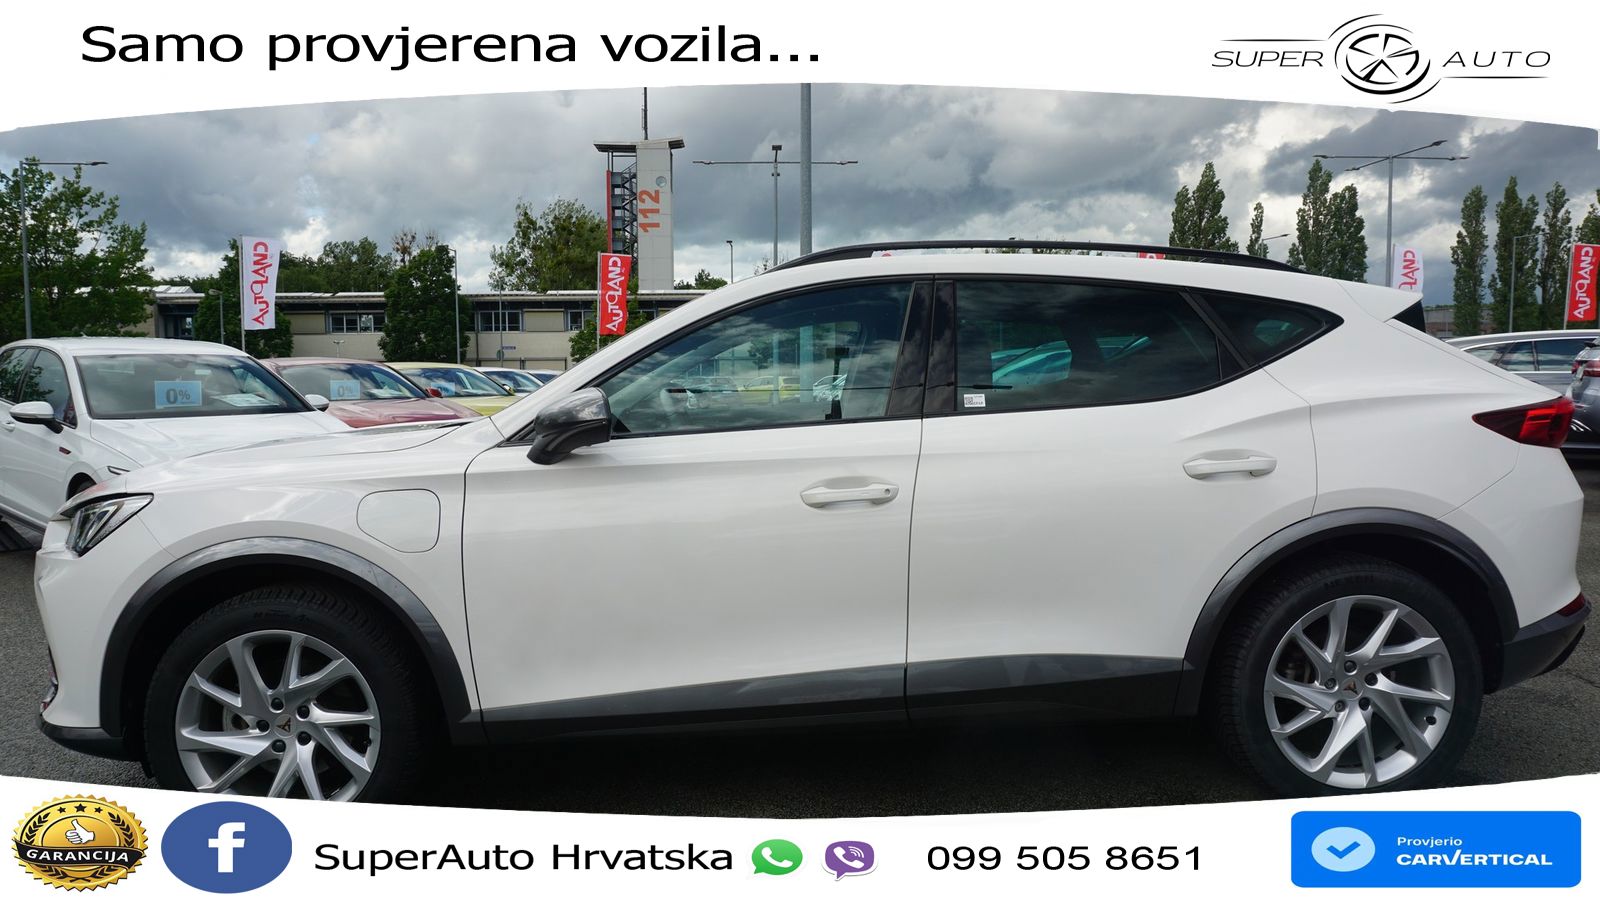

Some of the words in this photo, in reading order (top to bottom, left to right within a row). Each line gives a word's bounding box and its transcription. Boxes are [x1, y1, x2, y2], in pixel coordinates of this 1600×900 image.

[638, 189, 660, 233] 112
[250, 241, 273, 326] AUTOLAND
[606, 256, 626, 332] AUTOLAND
[1573, 247, 1594, 319] AUTOLAND
[165, 388, 191, 404] 0%
